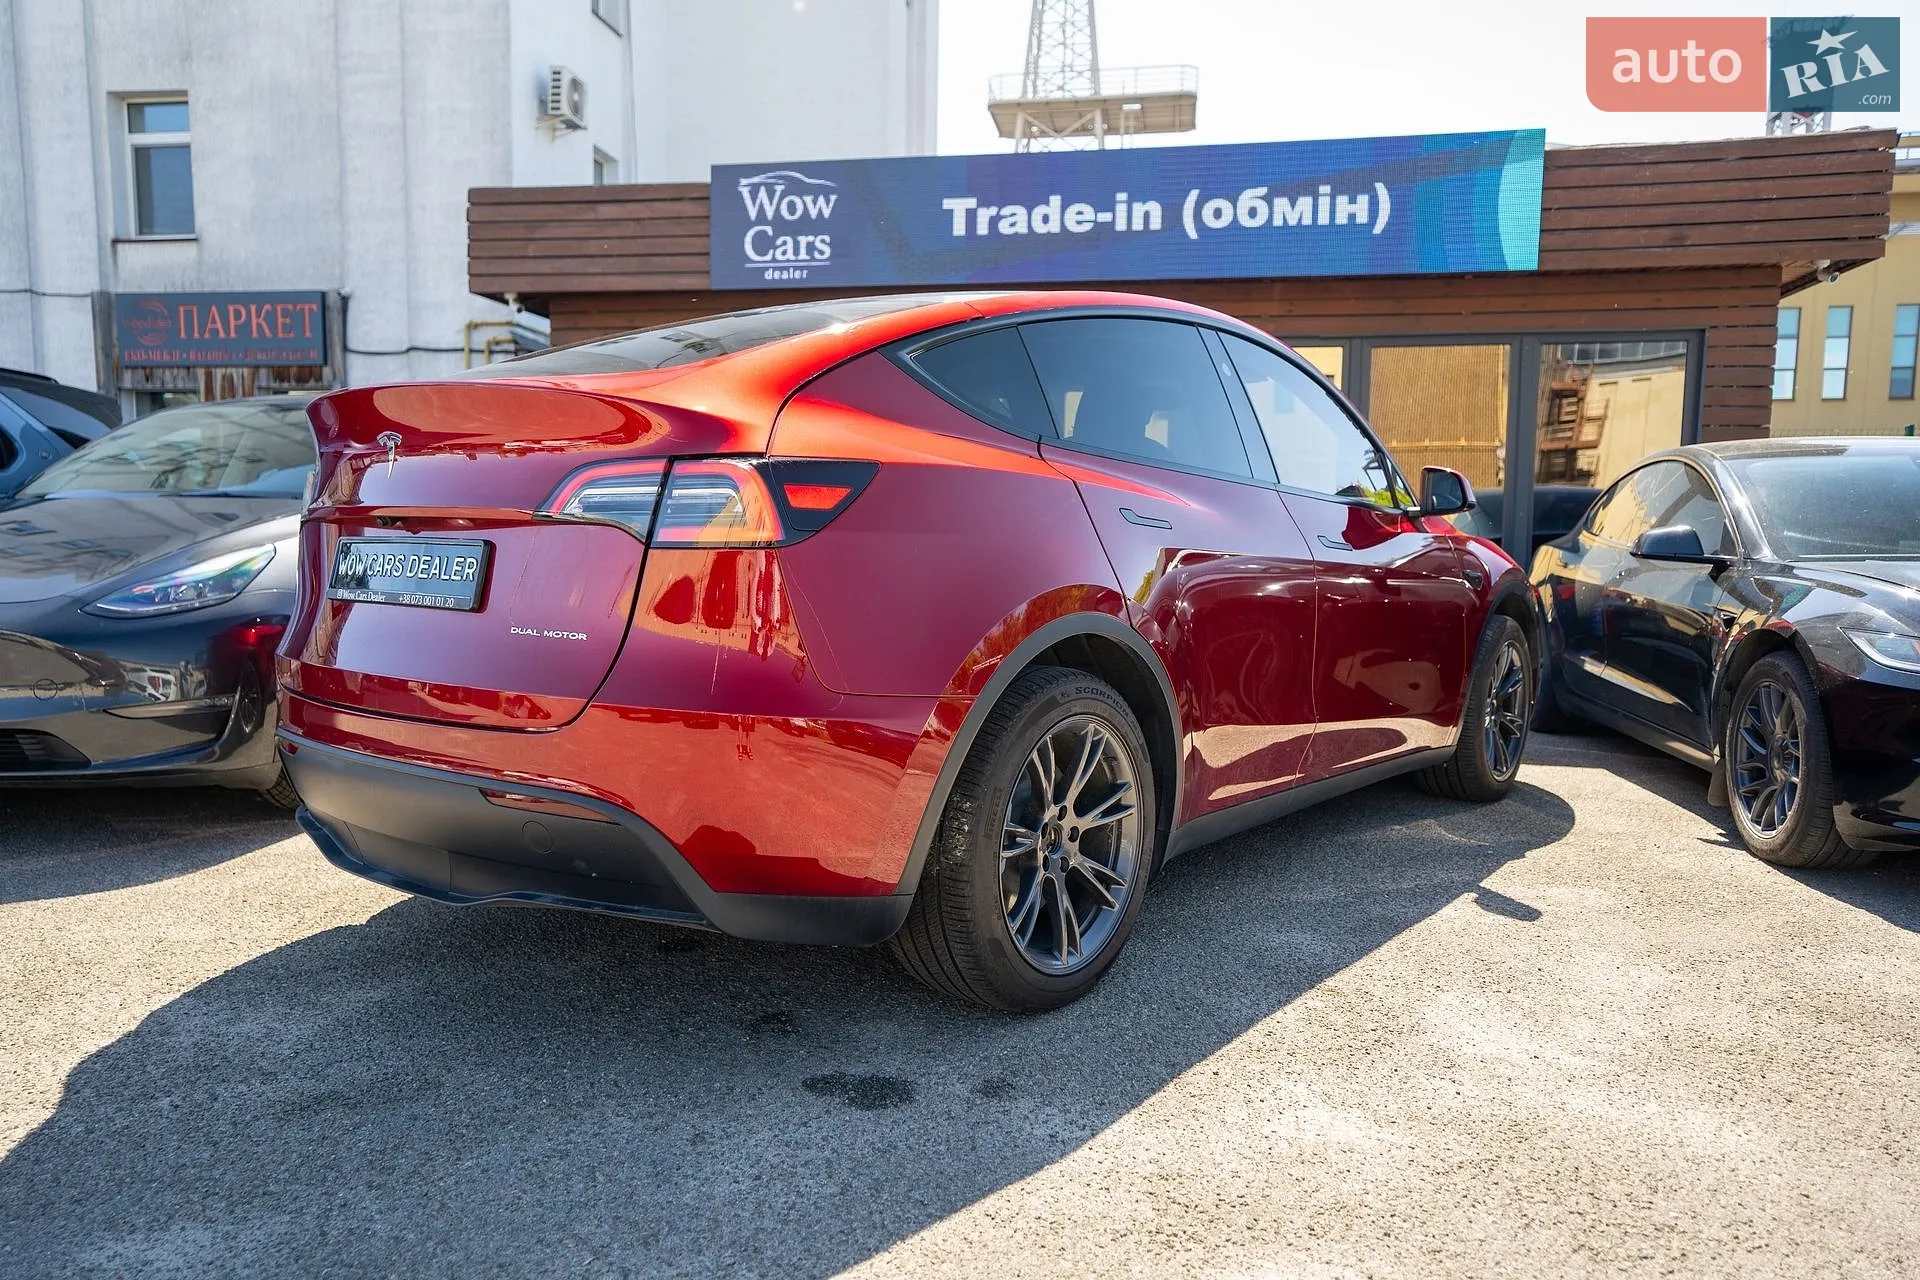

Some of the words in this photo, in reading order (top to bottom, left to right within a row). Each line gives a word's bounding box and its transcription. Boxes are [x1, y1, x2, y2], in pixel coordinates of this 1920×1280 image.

[942, 192, 1162, 236] Trade-in
[1182, 182, 1391, 240] (обмін)
[744, 225, 831, 262] Cars
[764, 267, 808, 280] dealer
[177, 303, 318, 340] ПАРКЕТ
[338, 553, 368, 577] WOW
[367, 553, 405, 577] CARS
[406, 555, 478, 581] DEALER
[445, 597, 454, 607] 20
[510, 627, 540, 636] DUAL
[543, 630, 587, 640] MOTOR
[1075, 686, 1129, 717] SCORPION
